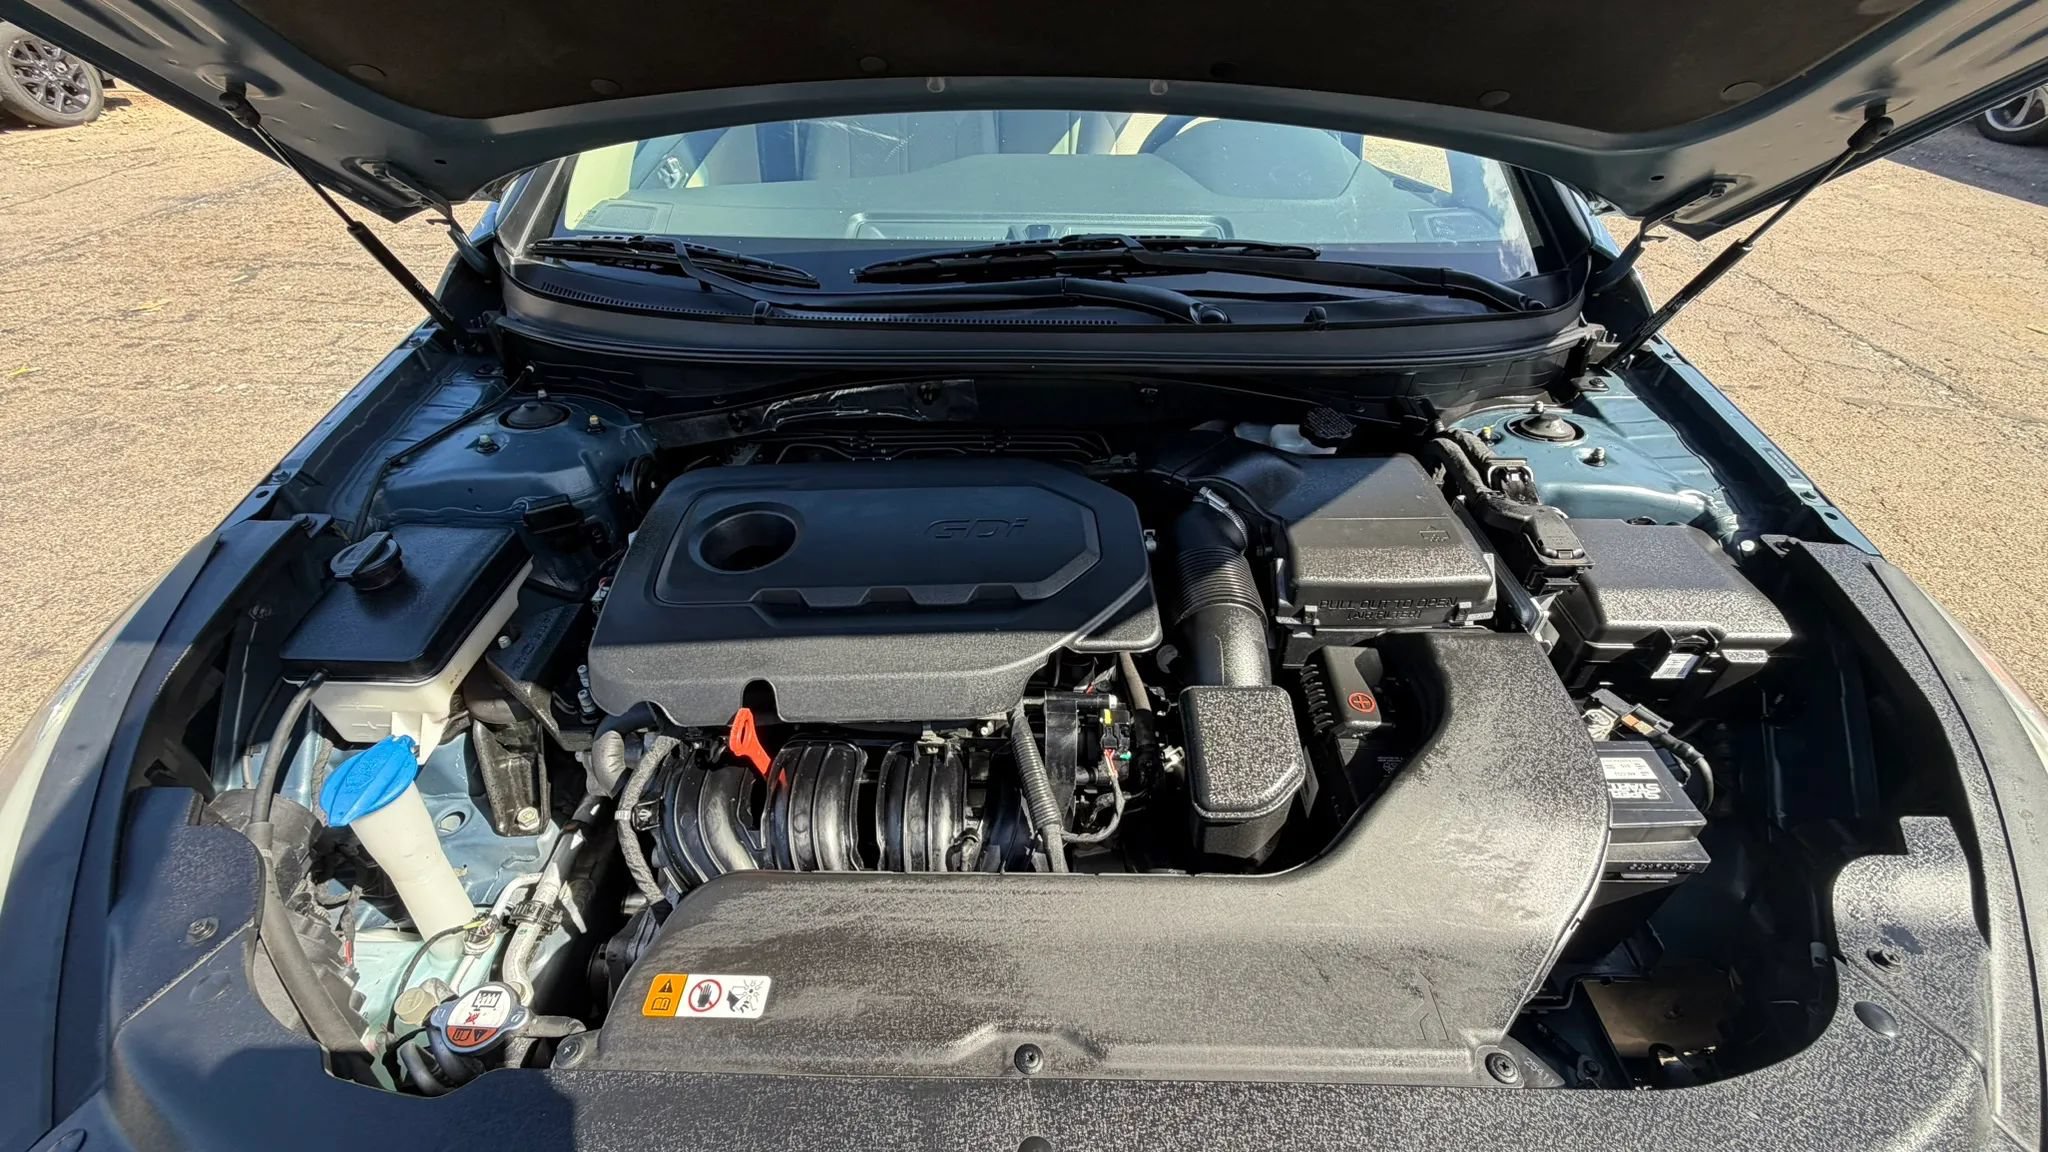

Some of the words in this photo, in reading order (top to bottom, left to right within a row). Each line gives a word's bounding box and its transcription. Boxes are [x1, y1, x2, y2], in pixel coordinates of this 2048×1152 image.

[1318, 599, 1356, 611] PULL
[1360, 598, 1392, 610] OUT
[1393, 598, 1414, 610] TO
[1416, 596, 1458, 609] OPEN
